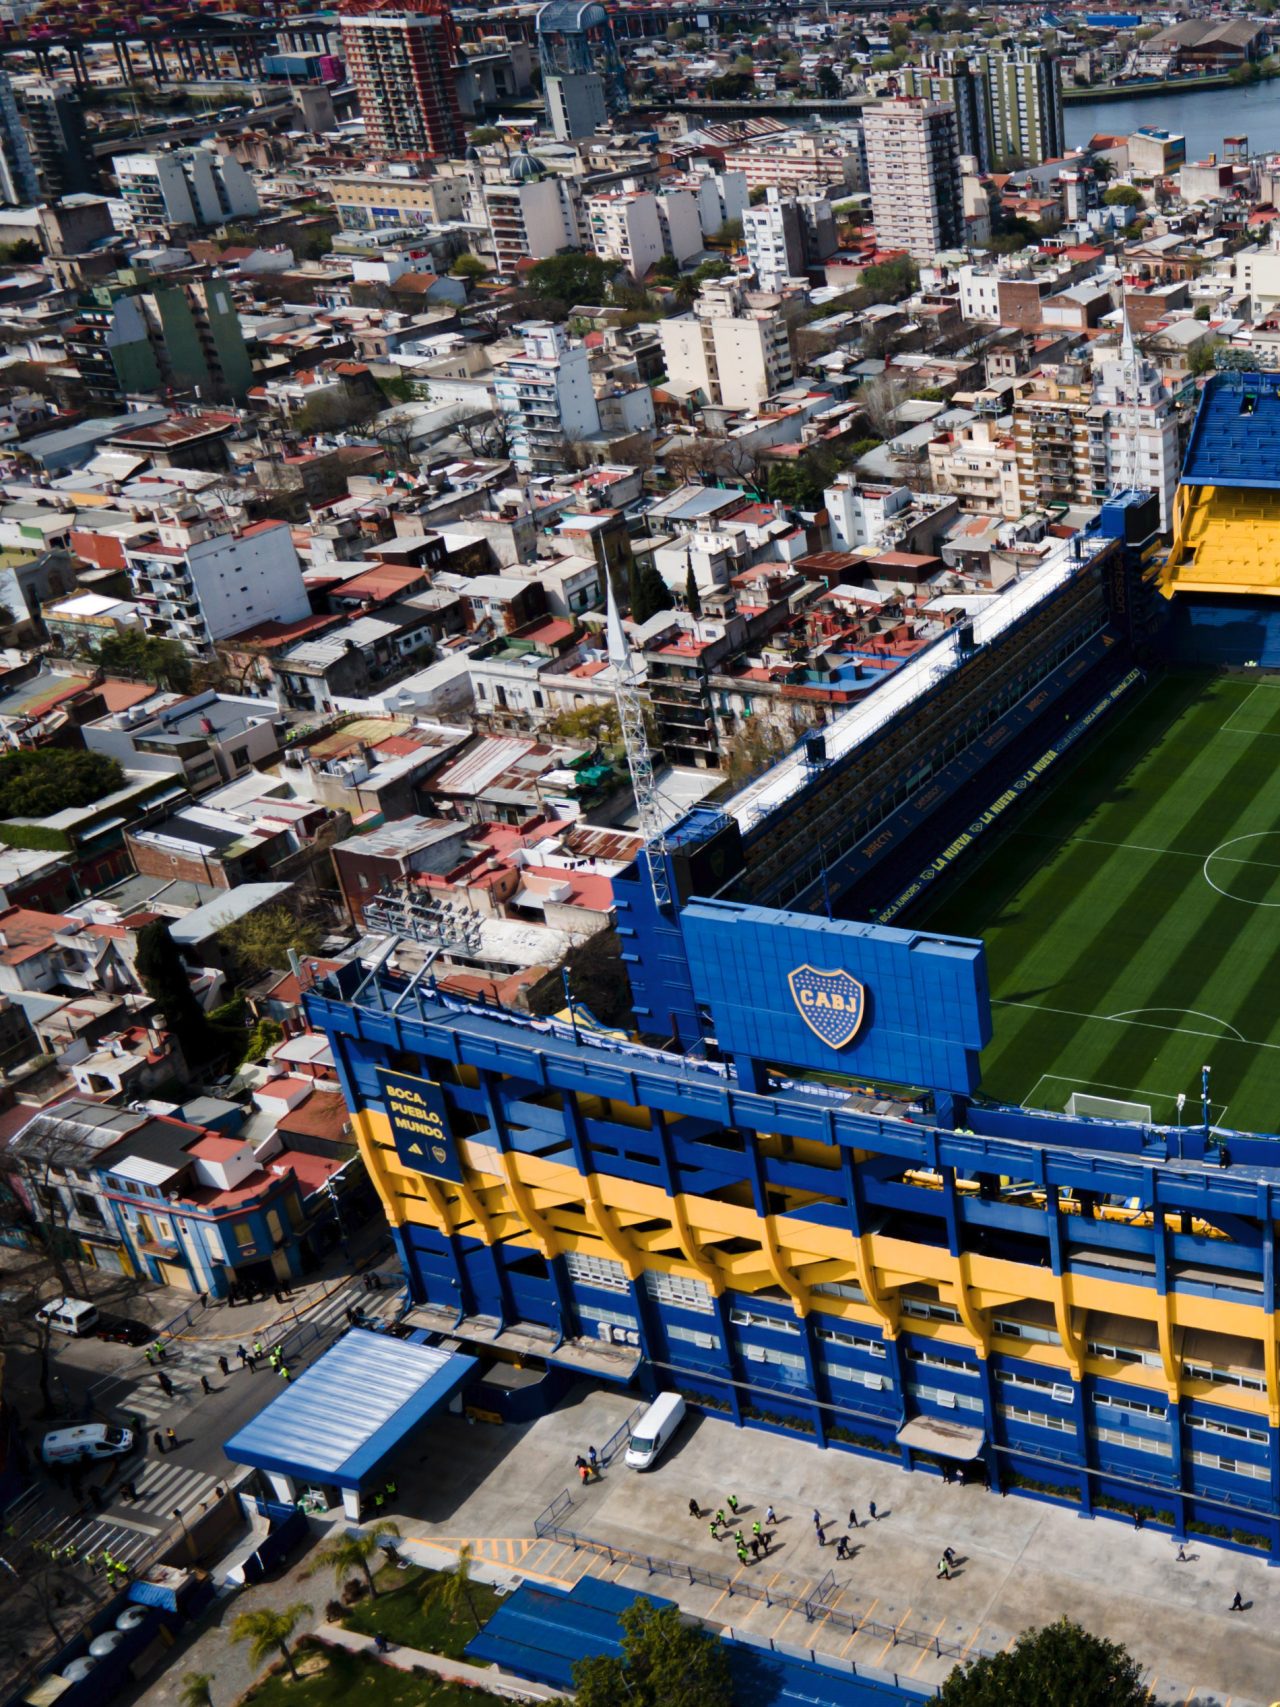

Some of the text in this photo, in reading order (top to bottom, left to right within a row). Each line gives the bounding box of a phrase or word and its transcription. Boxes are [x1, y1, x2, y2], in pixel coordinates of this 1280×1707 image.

[931, 857, 947, 871] LA
[943, 833, 973, 860] NUEVA
[979, 812, 993, 824] LA
[989, 789, 1017, 814] NUEVA
[1023, 770, 1038, 782] LA
[1032, 749, 1058, 773] NUEVA
[879, 882, 920, 923] BOCA JUNIORS
[800, 989, 857, 1013] CABJ
[385, 1084, 427, 1107] BOCA,
[390, 1101, 443, 1126] PUEBLO,
[394, 1116, 447, 1141] MUNDO.
